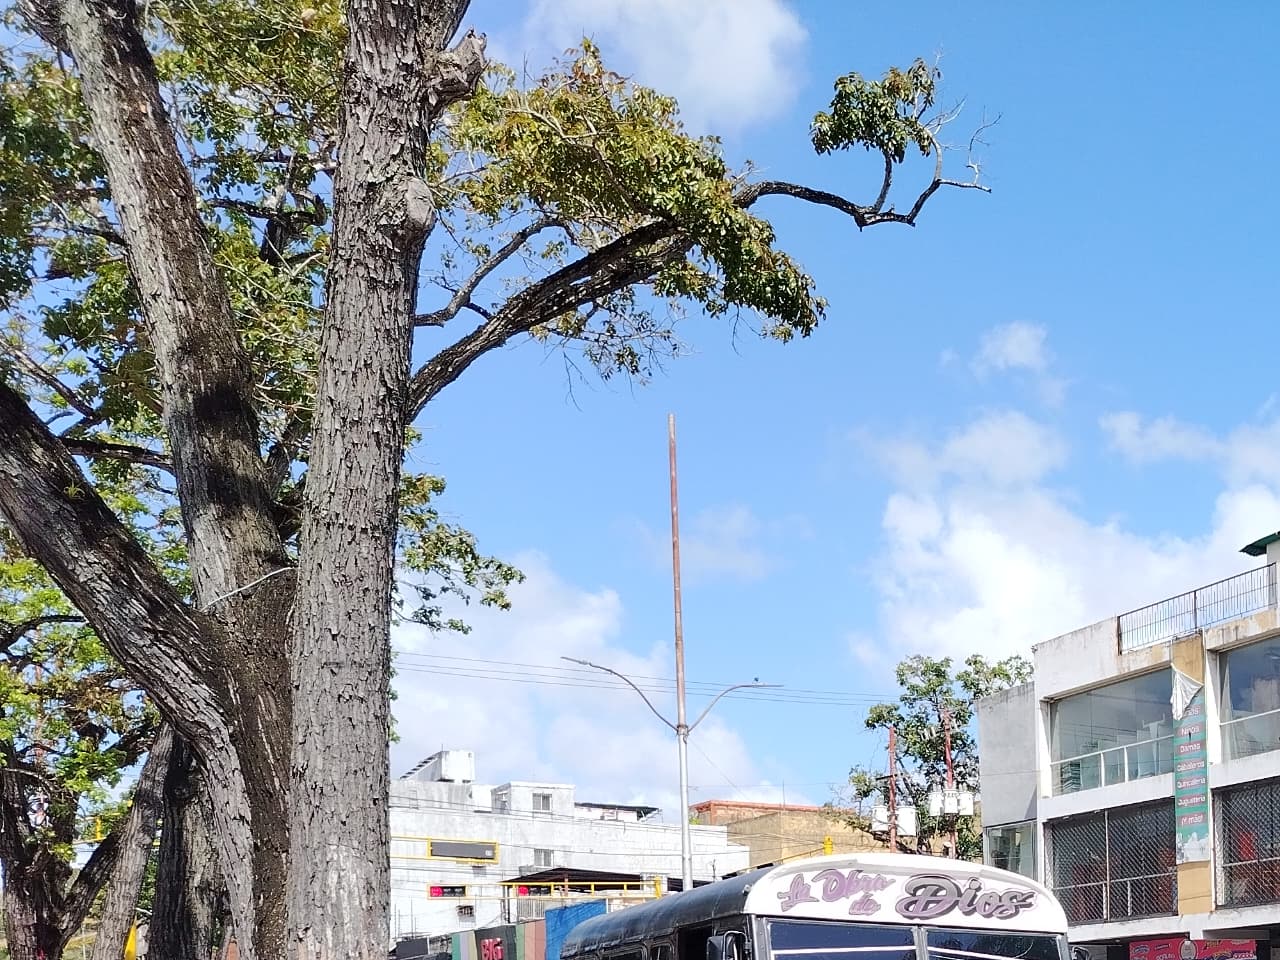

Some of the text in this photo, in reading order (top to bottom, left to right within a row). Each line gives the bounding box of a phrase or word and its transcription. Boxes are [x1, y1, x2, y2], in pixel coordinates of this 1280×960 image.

[1180, 743, 1201, 753] Damas
[777, 868, 1037, 920] La Obra de Dios
